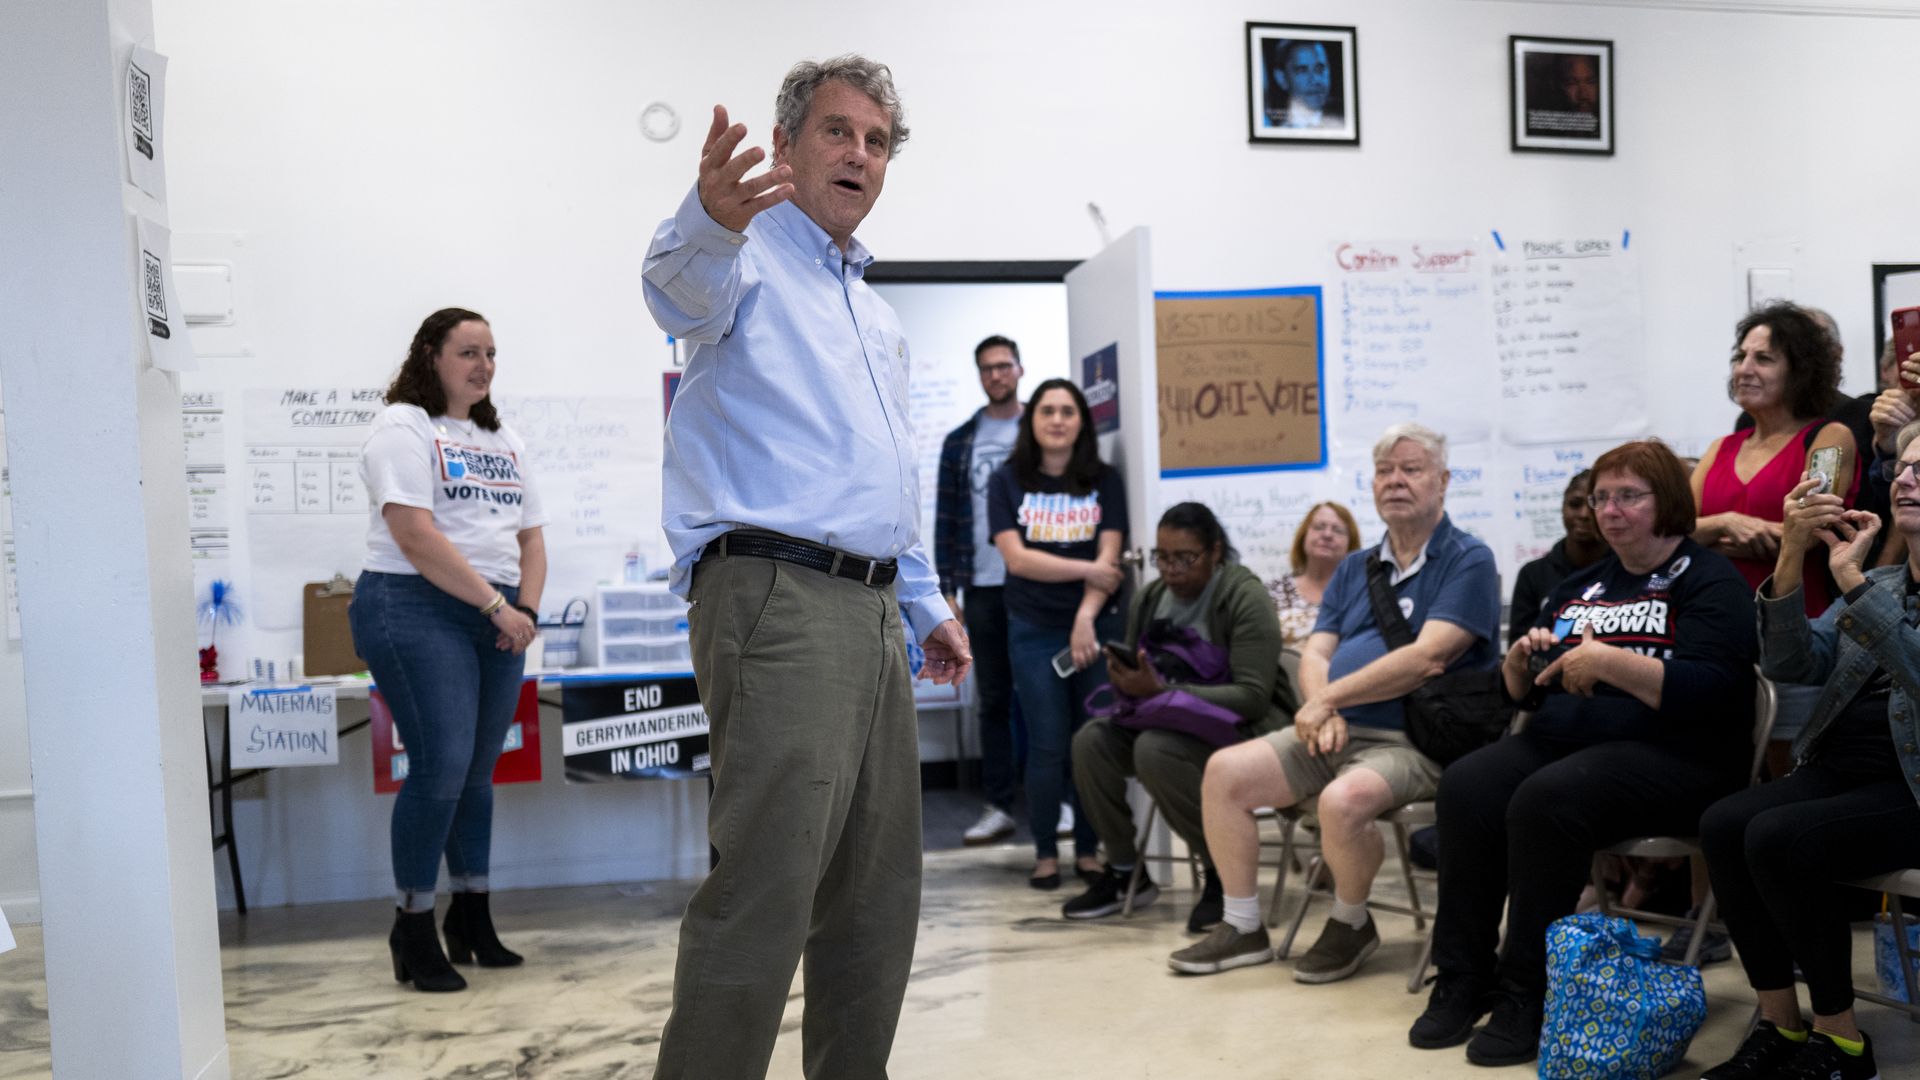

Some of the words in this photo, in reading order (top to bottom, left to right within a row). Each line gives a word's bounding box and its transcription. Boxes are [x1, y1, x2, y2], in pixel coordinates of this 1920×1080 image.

[1411, 244, 1475, 270] Support
[280, 390, 320, 405] MAKE
[326, 391, 338, 404] A
[444, 486, 491, 502] VOTE
[1018, 505, 1102, 525] SHERROD
[1027, 524, 1097, 543] BROWN
[1560, 599, 1668, 620] SHERROD
[1571, 615, 1666, 635] BROWN
[240, 693, 333, 715] MATERIALS
[624, 684, 662, 712] END
[246, 724, 328, 756] STATION
[576, 711, 709, 748] GERRYMANDERING
[611, 750, 632, 775] IN
[634, 741, 680, 770] OHIO
